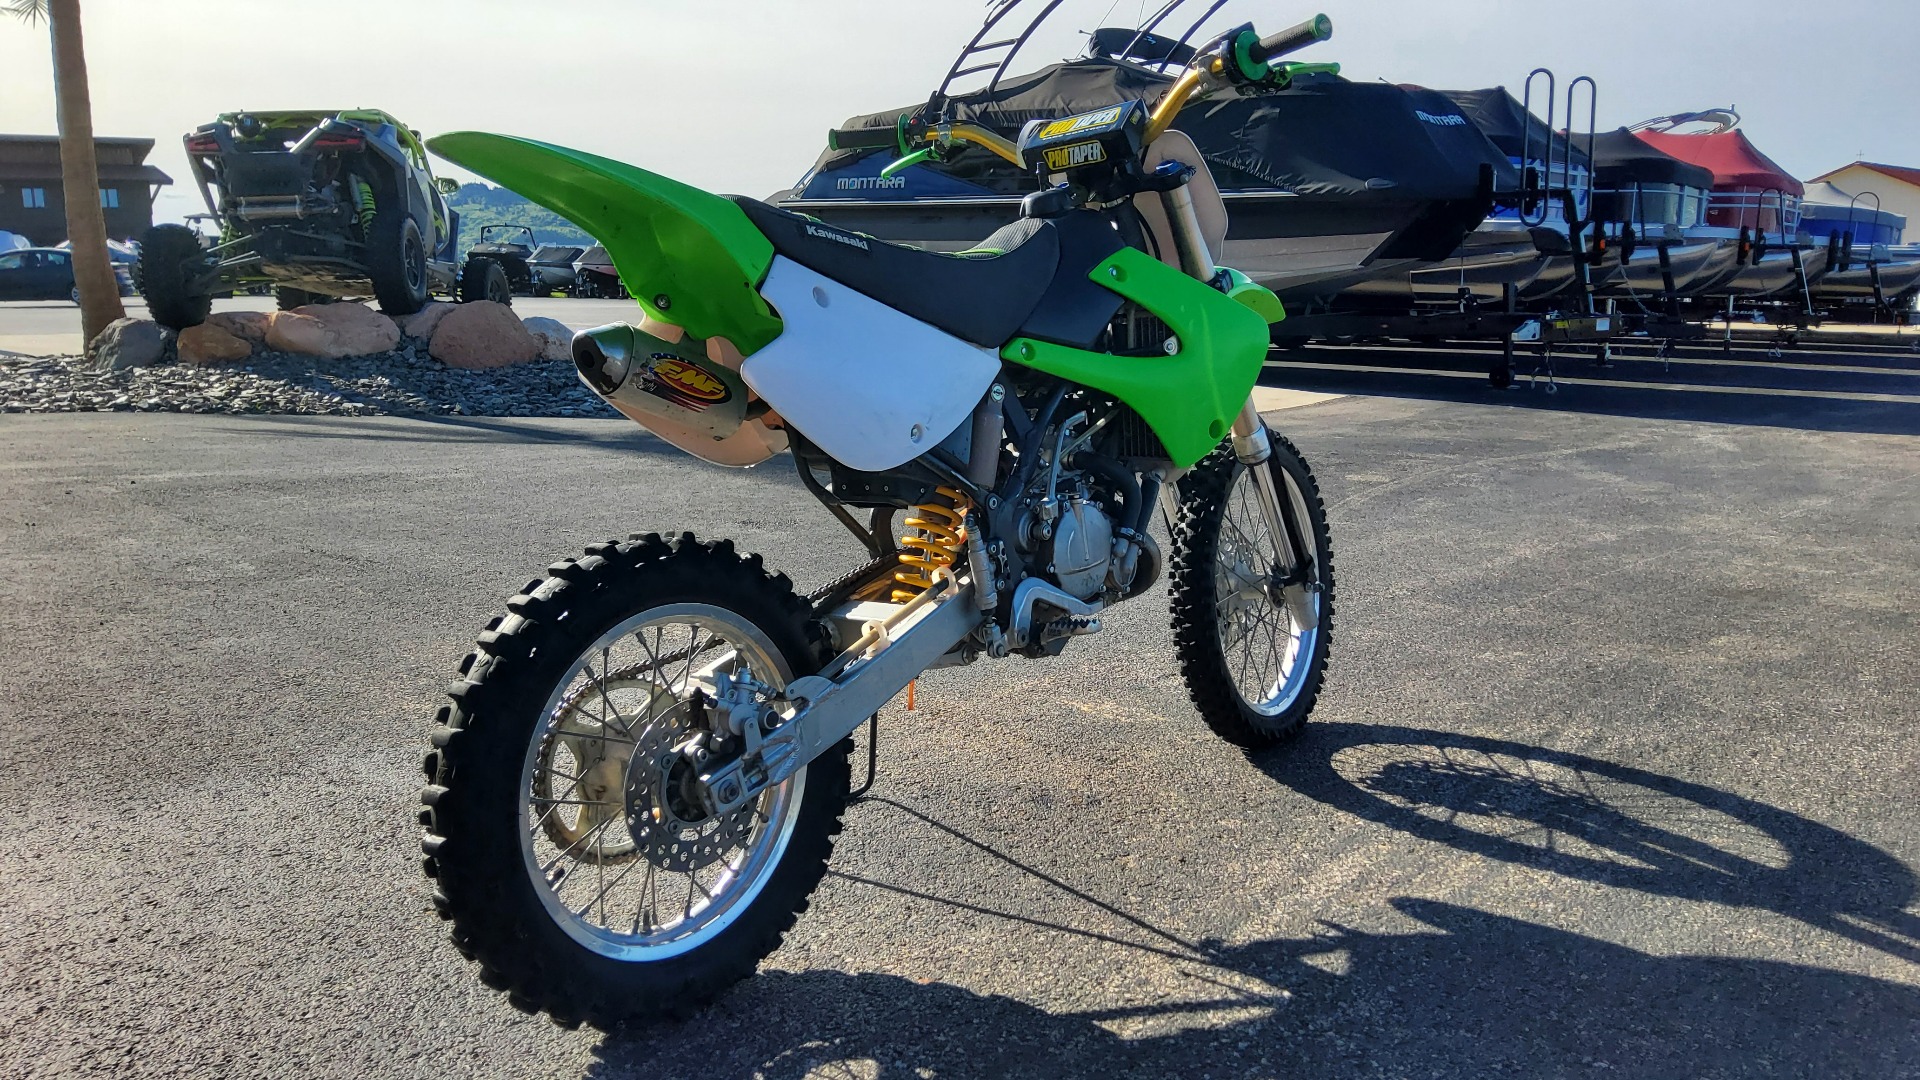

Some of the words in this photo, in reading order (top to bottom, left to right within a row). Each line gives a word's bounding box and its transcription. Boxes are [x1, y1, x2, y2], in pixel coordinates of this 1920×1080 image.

[1047, 142, 1101, 167] PROTAPER
[836, 176, 906, 190] MONTARA
[805, 224, 869, 251] Kawasaki
[653, 362, 725, 394] FMF
